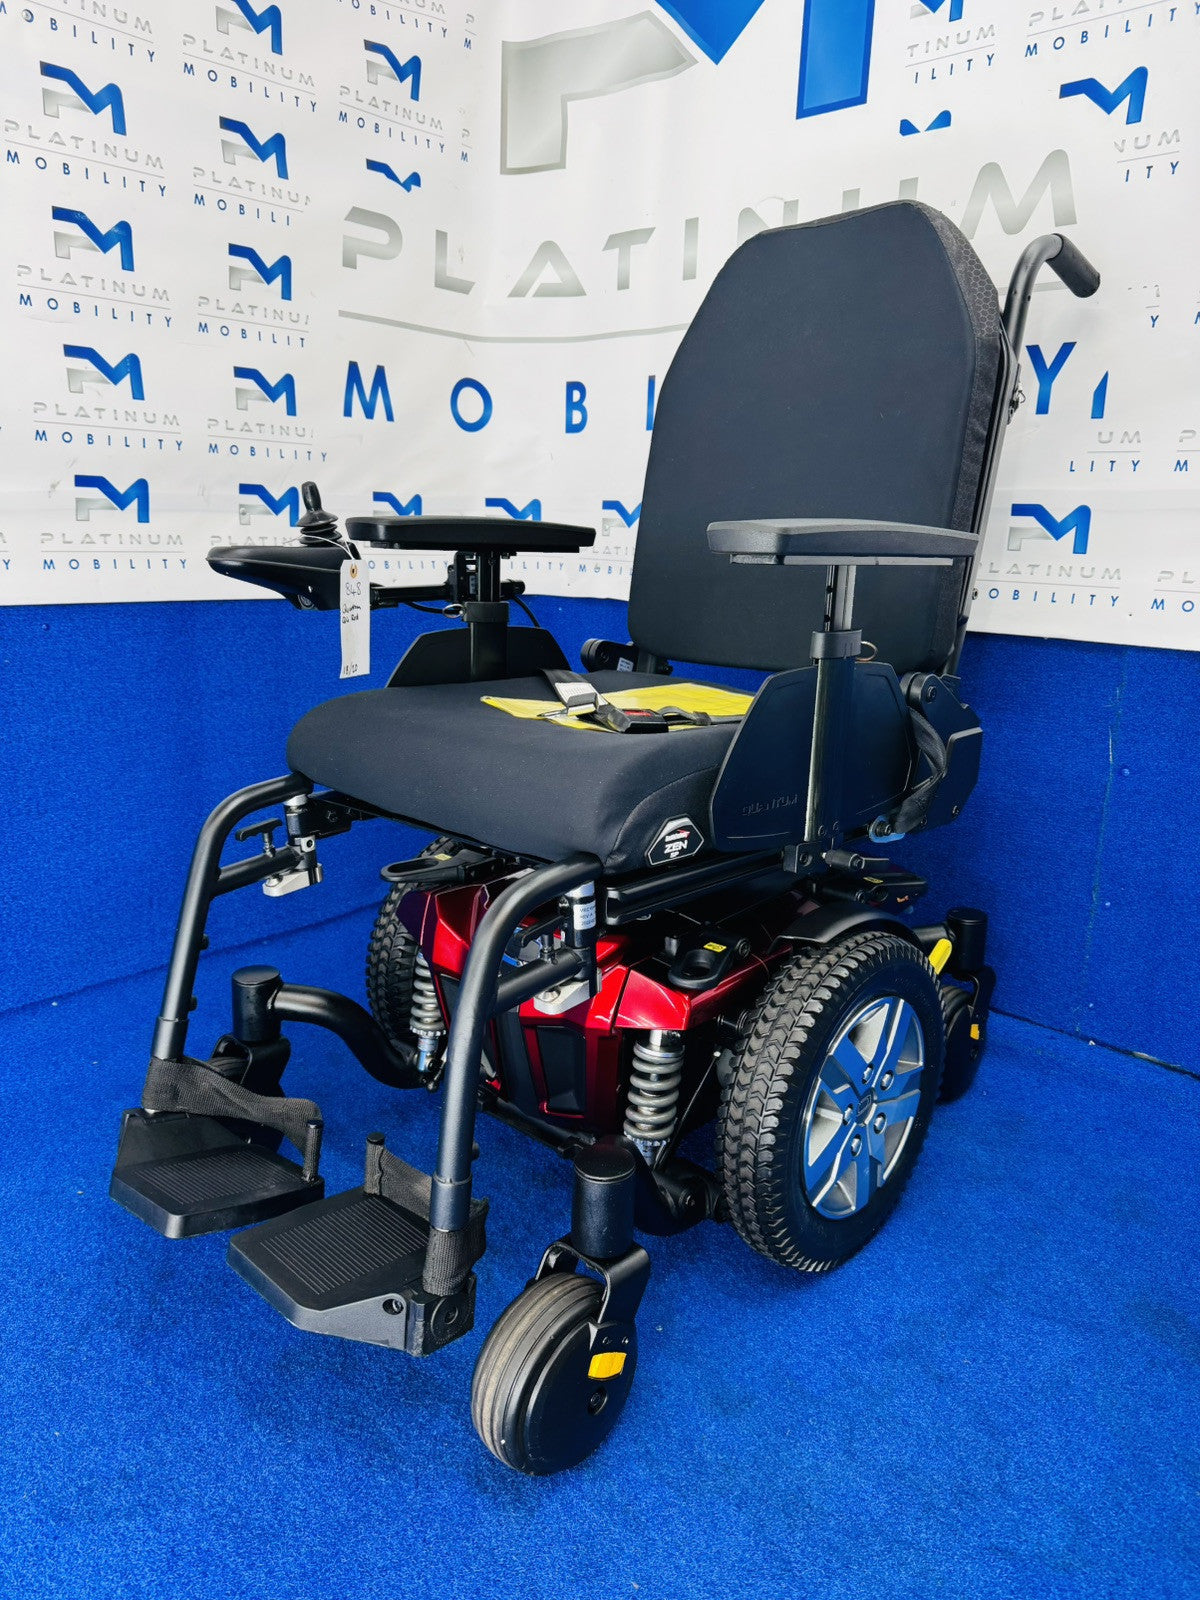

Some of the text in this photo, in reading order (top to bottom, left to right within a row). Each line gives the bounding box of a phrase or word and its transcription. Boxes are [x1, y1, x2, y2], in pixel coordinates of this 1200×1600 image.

[182, 33, 315, 87] PLATINUM
[183, 62, 317, 112] MOBILITY
[339, 85, 443, 130] PLATINUM
[4, 119, 164, 169] PLATINUM
[339, 111, 445, 153] MOBILITY
[7, 150, 167, 197] MOBILITY
[16, 264, 170, 301] PLATINUM
[19, 293, 172, 328] MOBILITY
[33, 402, 180, 426] PLATINUM
[35, 430, 183, 450] MOBILITY
[208, 443, 328, 462] MOBILITY
[40, 533, 183, 545] PLATINUM
[43, 558, 187, 570] MOBILITY
[345, 581, 362, 596] 848
